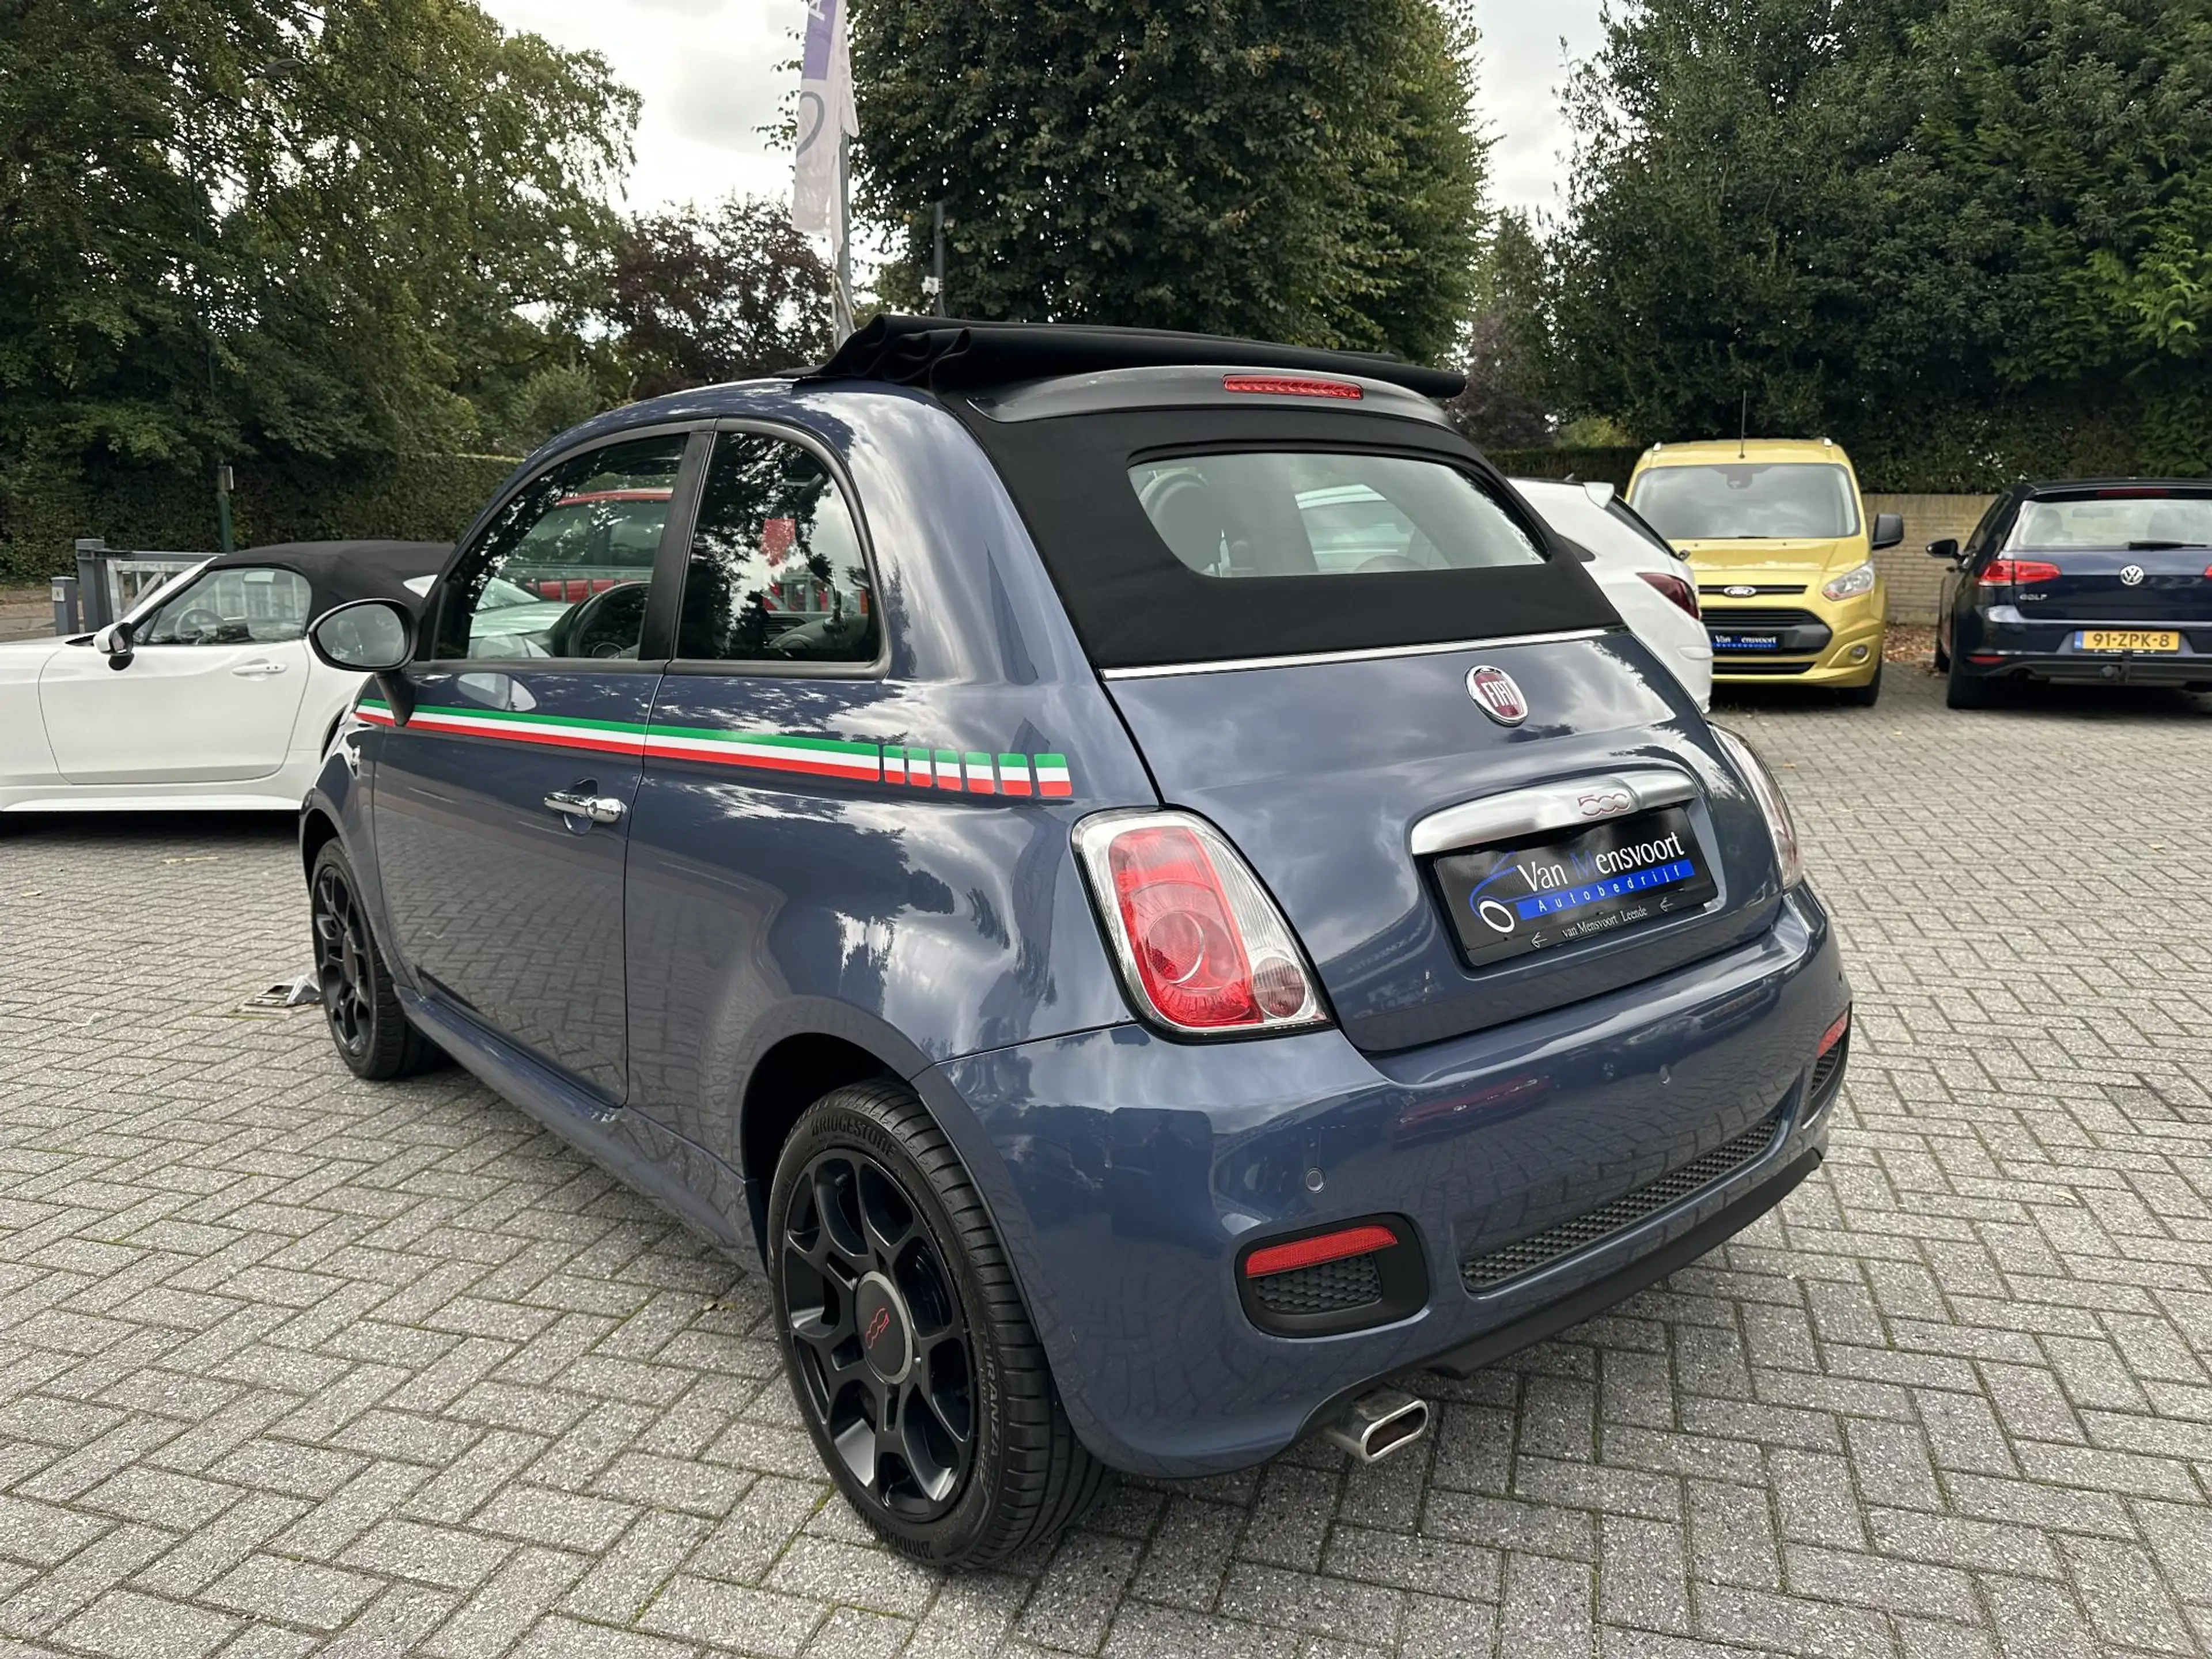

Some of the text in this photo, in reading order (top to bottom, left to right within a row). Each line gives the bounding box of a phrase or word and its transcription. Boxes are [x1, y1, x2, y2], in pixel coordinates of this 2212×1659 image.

[1715, 635, 1732, 643] Van
[2093, 632, 2170, 647] 91-ZPK-8
[1479, 680, 1518, 707] FIAT
[1577, 793, 1631, 817] 500
[1517, 831, 1685, 892] Van Mensvoort
[1538, 865, 1680, 913] Autobedrijf
[1562, 905, 1648, 939] van Mensvoort Leende
[810, 1115, 898, 1158] BRIDGESTONE
[979, 1322, 1000, 1456] TURANZA
